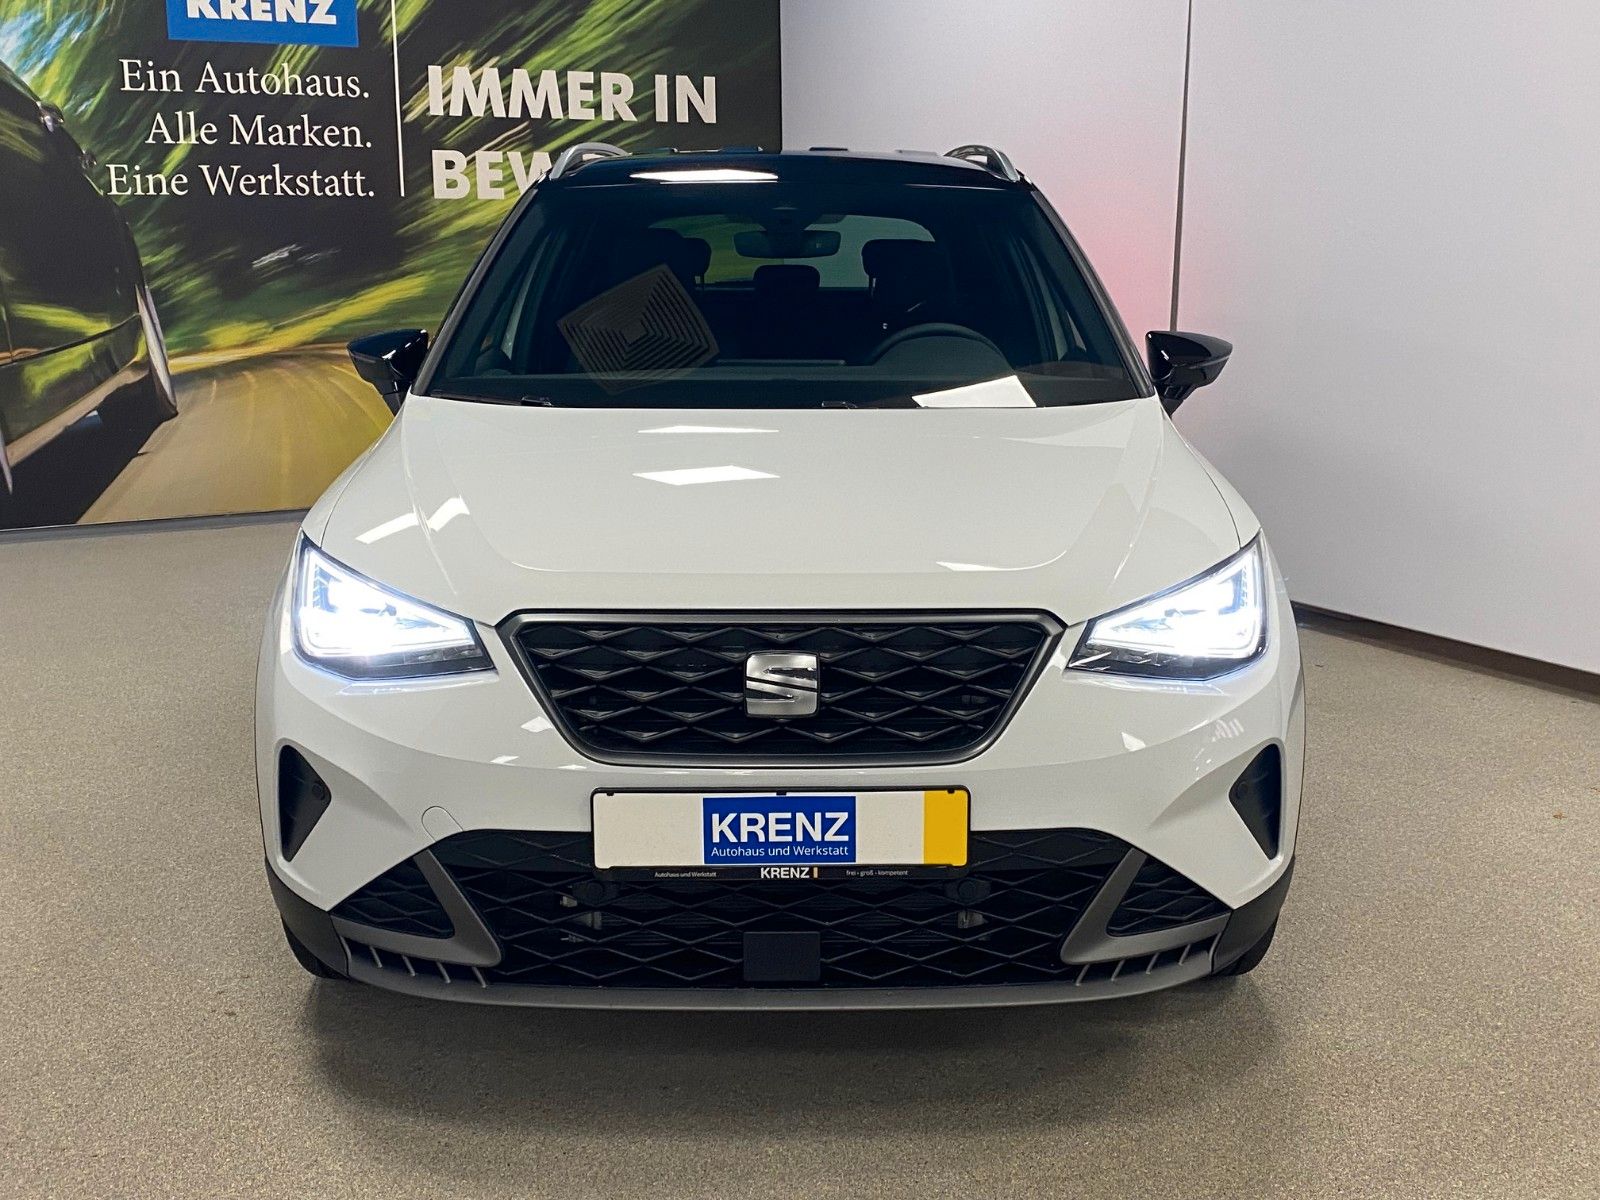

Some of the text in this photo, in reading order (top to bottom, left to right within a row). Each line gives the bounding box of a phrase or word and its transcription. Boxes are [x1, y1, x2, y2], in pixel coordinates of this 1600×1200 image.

[118, 58, 370, 99] Ein Autohaus.
[427, 64, 718, 124] IMMER IN
[145, 110, 373, 149] Alle Marken.
[105, 163, 376, 198] Eine Werkstatt.
[711, 811, 850, 843] KRENZ
[710, 845, 849, 857] Autohaus und Werkstatt
[760, 867, 810, 879] KRENZ
